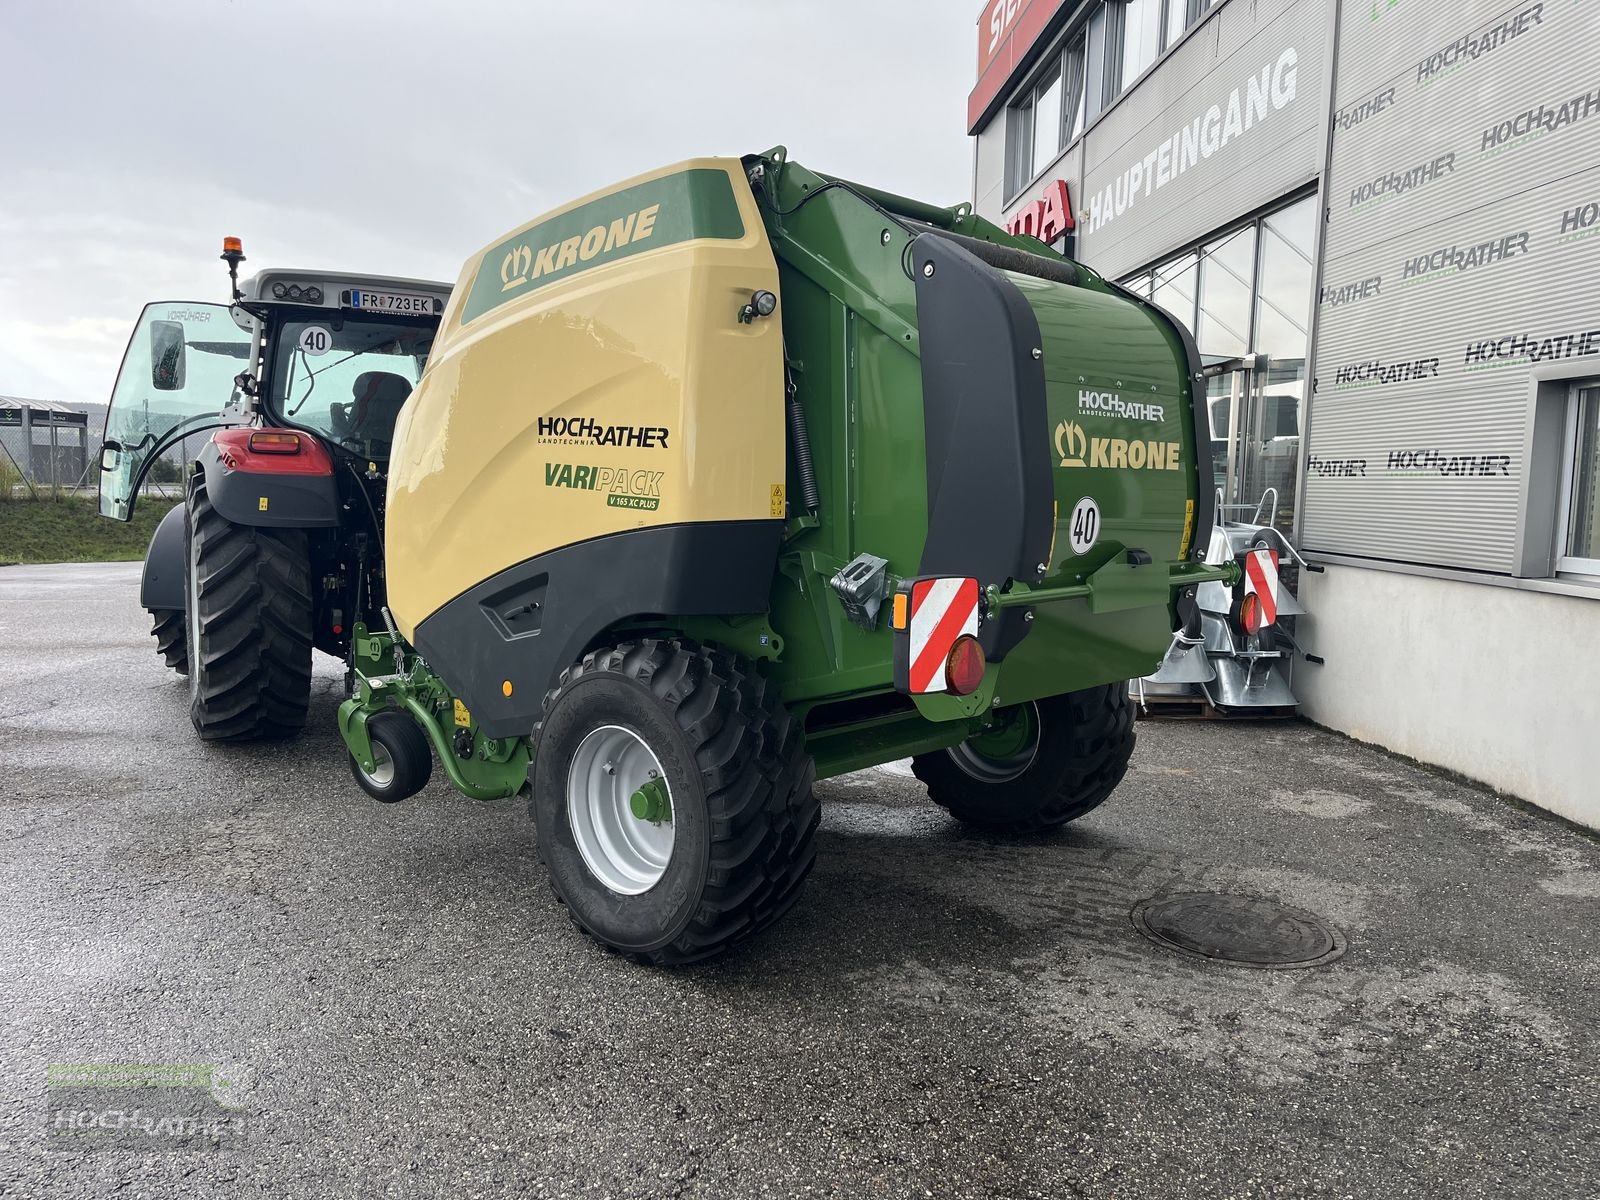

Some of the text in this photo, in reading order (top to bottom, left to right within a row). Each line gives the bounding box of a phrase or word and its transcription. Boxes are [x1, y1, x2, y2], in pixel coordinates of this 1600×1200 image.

[1416, 3, 1544, 84] HOCHRATHER
[1089, 48, 1298, 234] HAUPTEINGANG
[1349, 152, 1456, 208] HOCHRATHER
[531, 204, 660, 280] KRONE
[1402, 231, 1530, 280] HOCHRATHER
[362, 294, 378, 307] FR
[388, 296, 411, 310] 723
[413, 299, 428, 312] EK
[304, 331, 326, 351] 40
[1335, 357, 1440, 385] HOCHRATHER
[1078, 389, 1165, 422] HOCHRATHER
[1078, 409, 1121, 418] LANDTECHNIK
[537, 417, 669, 448] HOCHRATHER
[537, 438, 595, 446] LANDTECHNIK
[1089, 437, 1180, 470] KRONE
[1386, 449, 1511, 477] HOCHRATHER
[545, 463, 665, 497] VARIPACK
[616, 497, 628, 506] 165
[628, 498, 639, 507] XC
[639, 500, 656, 509] PLUS
[1073, 507, 1096, 545] 40
